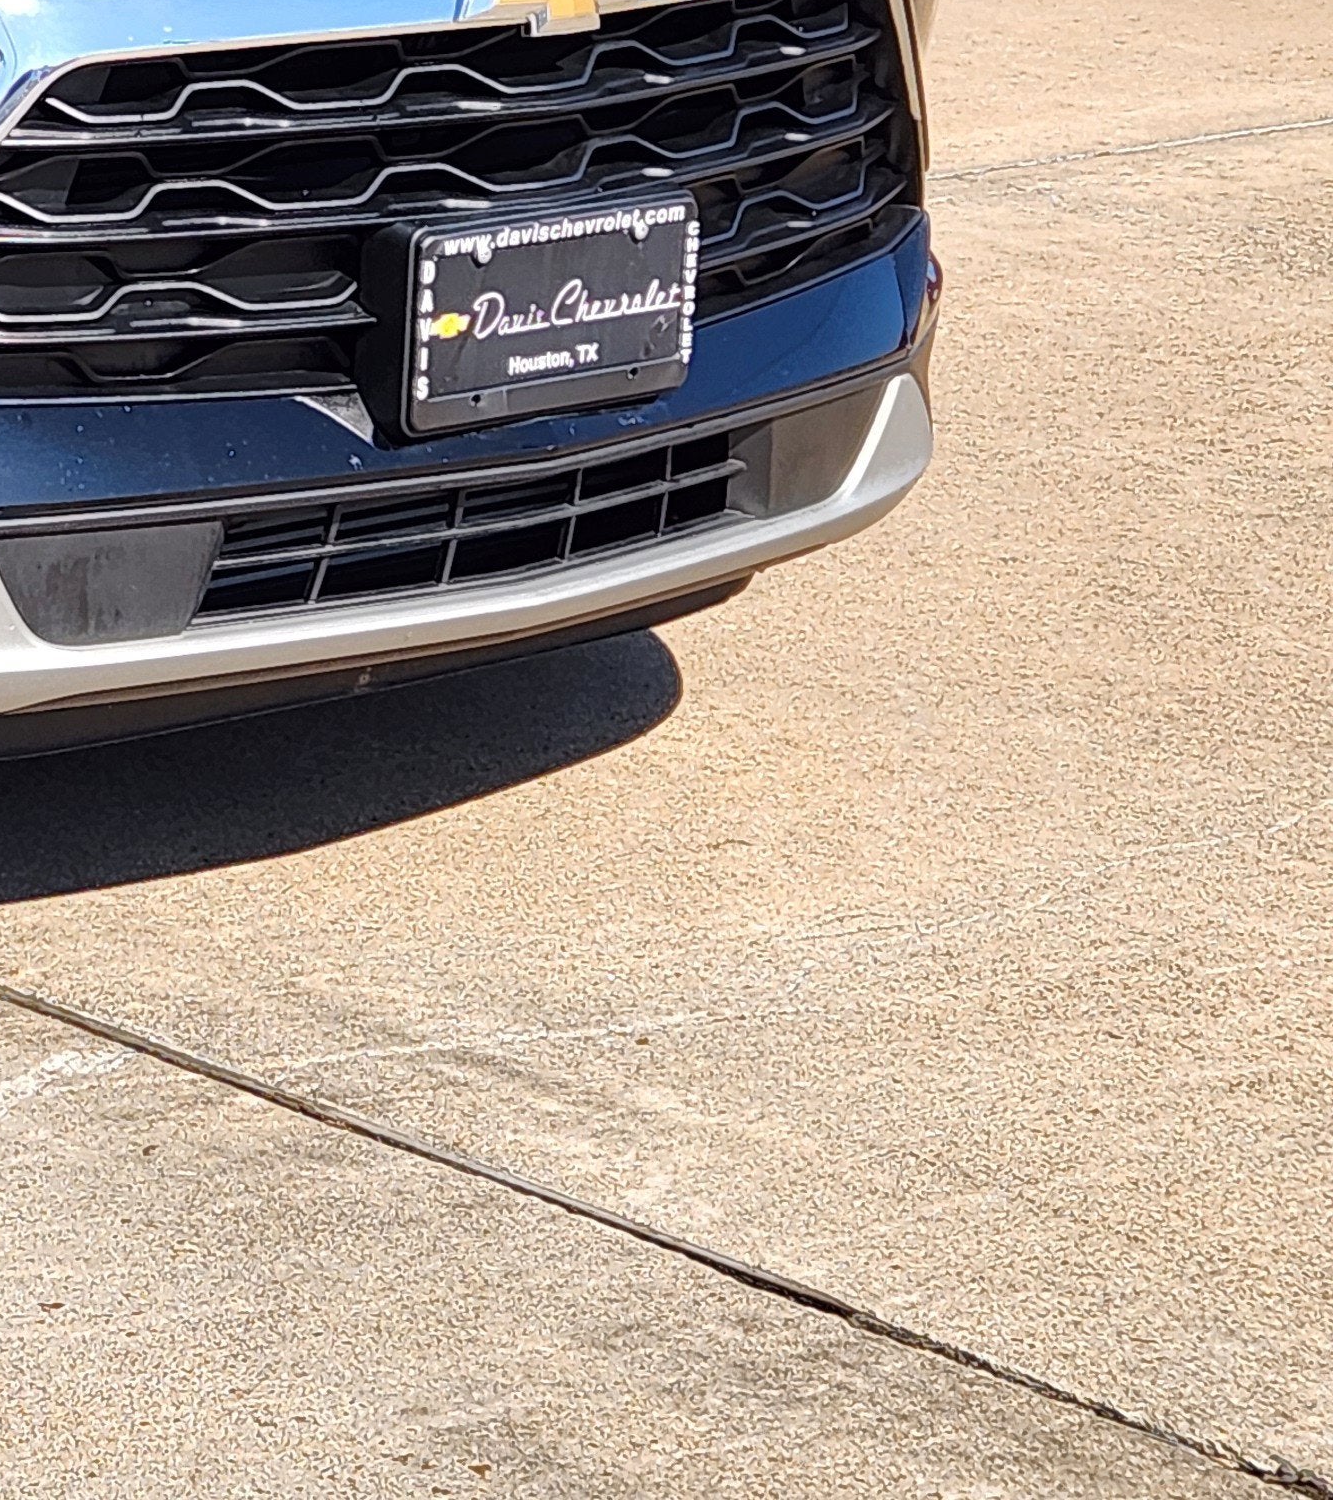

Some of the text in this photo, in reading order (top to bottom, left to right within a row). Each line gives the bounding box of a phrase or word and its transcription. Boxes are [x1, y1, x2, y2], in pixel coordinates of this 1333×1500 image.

[443, 204, 687, 257] www.davischevrolet.com
[473, 278, 682, 340] Davis Chevrolet
[680, 221, 701, 364] CHEVROLET
[415, 259, 437, 402] DAVIS
[507, 342, 600, 377] Houston, TX
